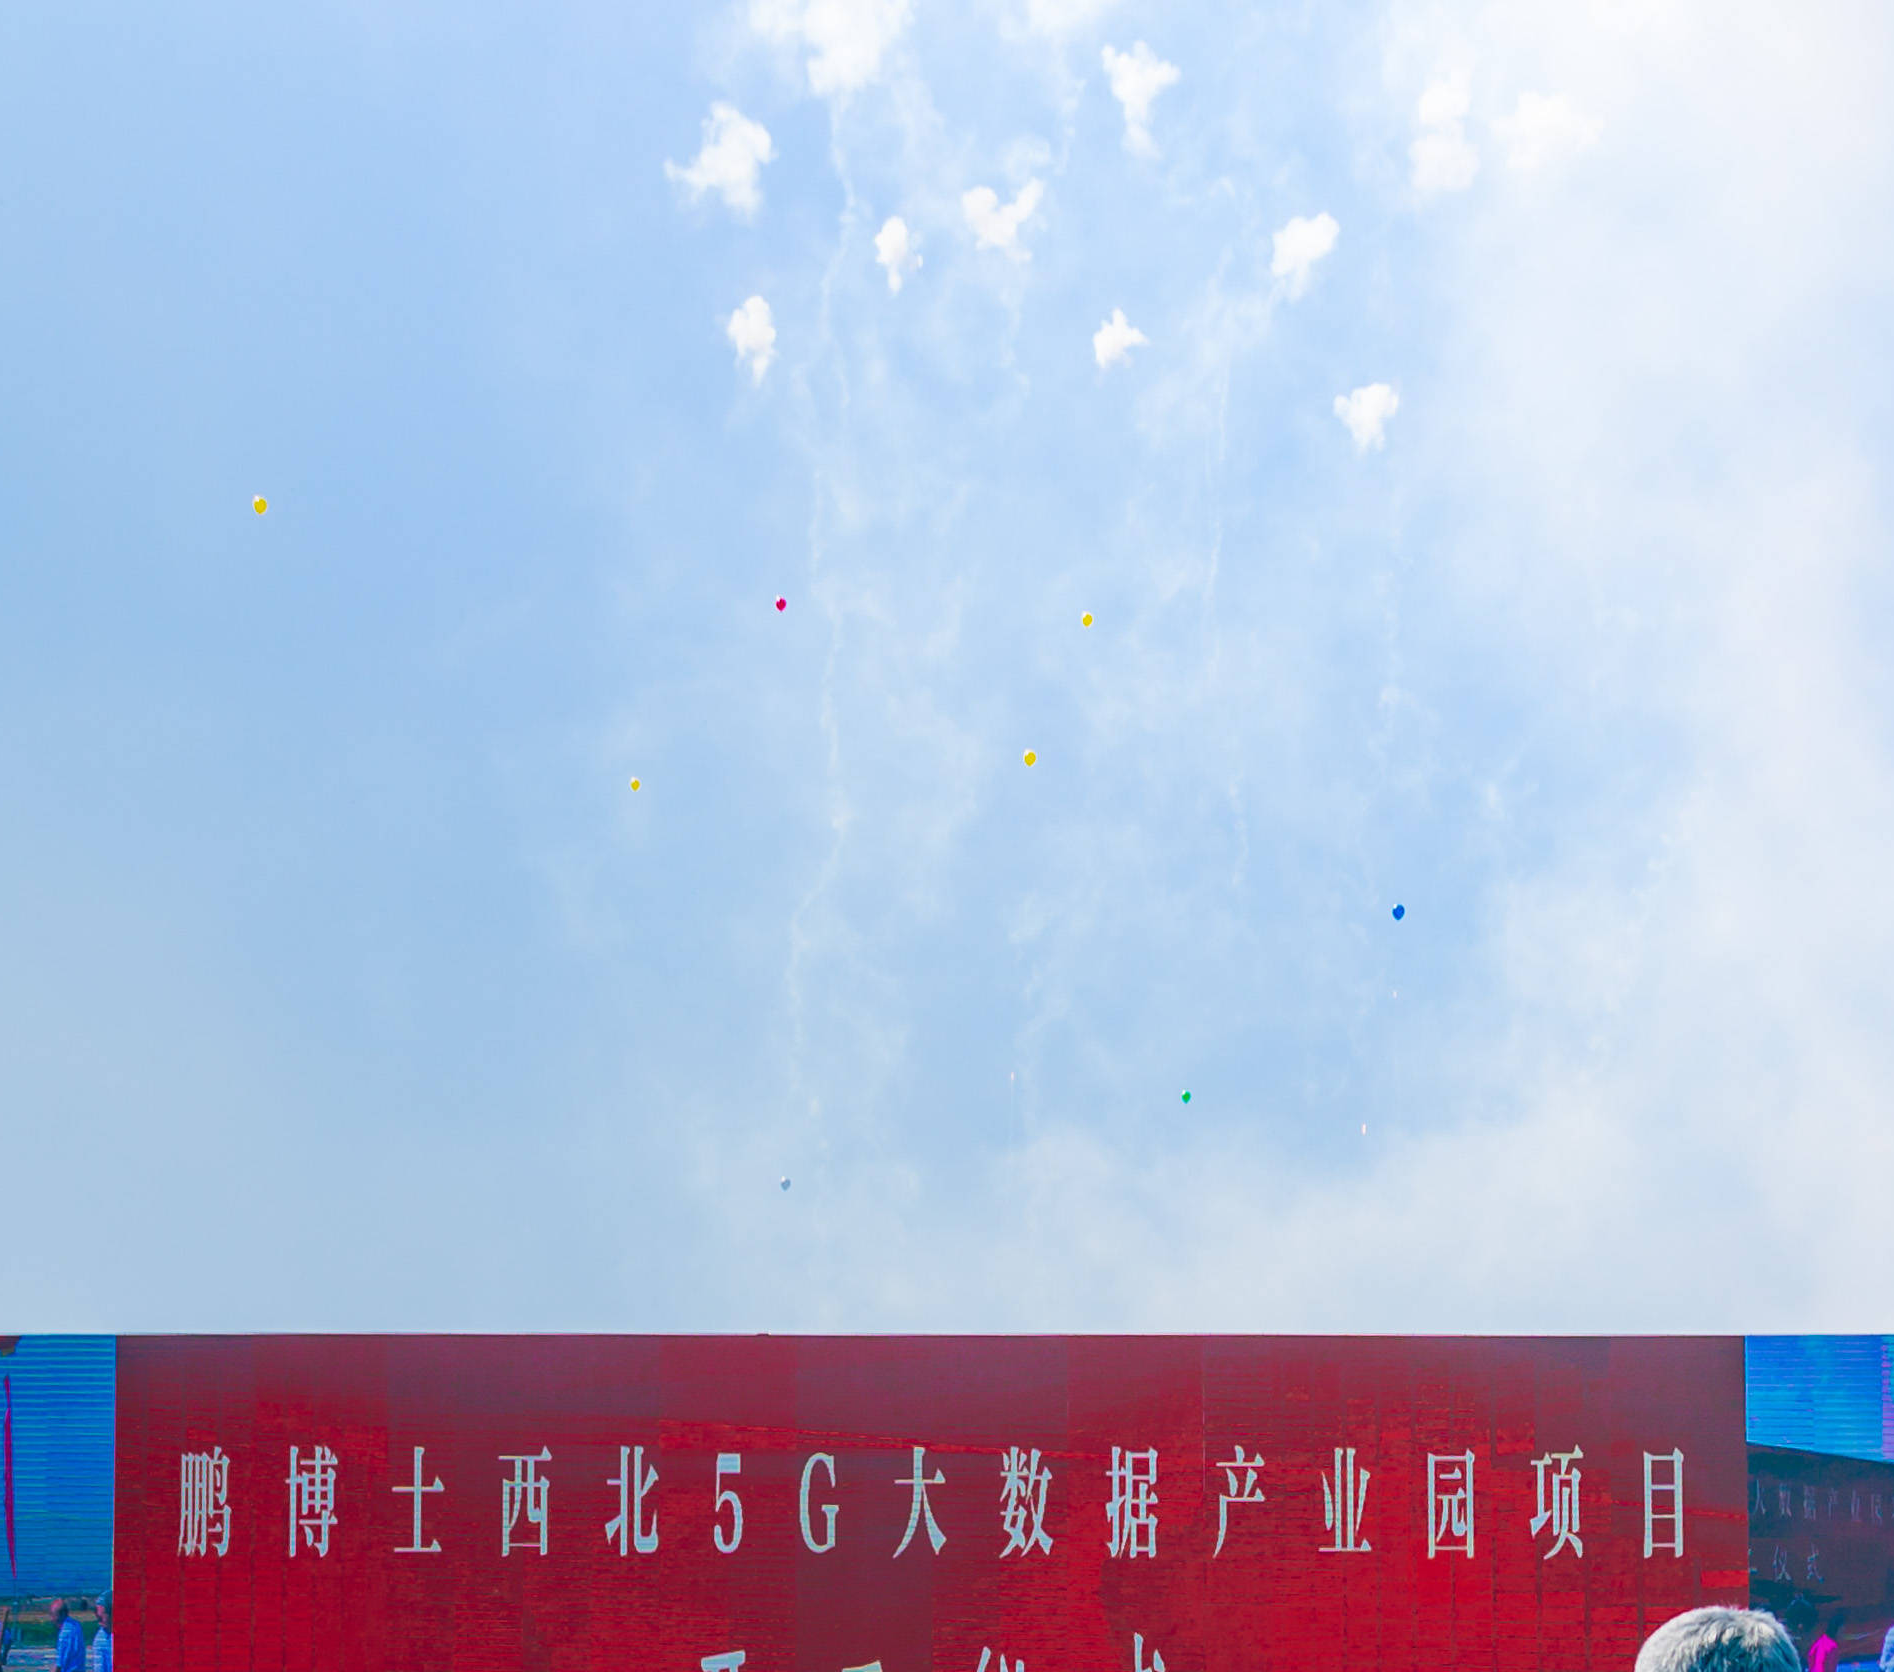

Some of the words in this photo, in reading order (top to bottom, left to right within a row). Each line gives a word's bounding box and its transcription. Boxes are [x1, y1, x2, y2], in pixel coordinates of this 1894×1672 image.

[178, 1444, 1687, 1560] 鹏博士西北5G大数据产业园项目
